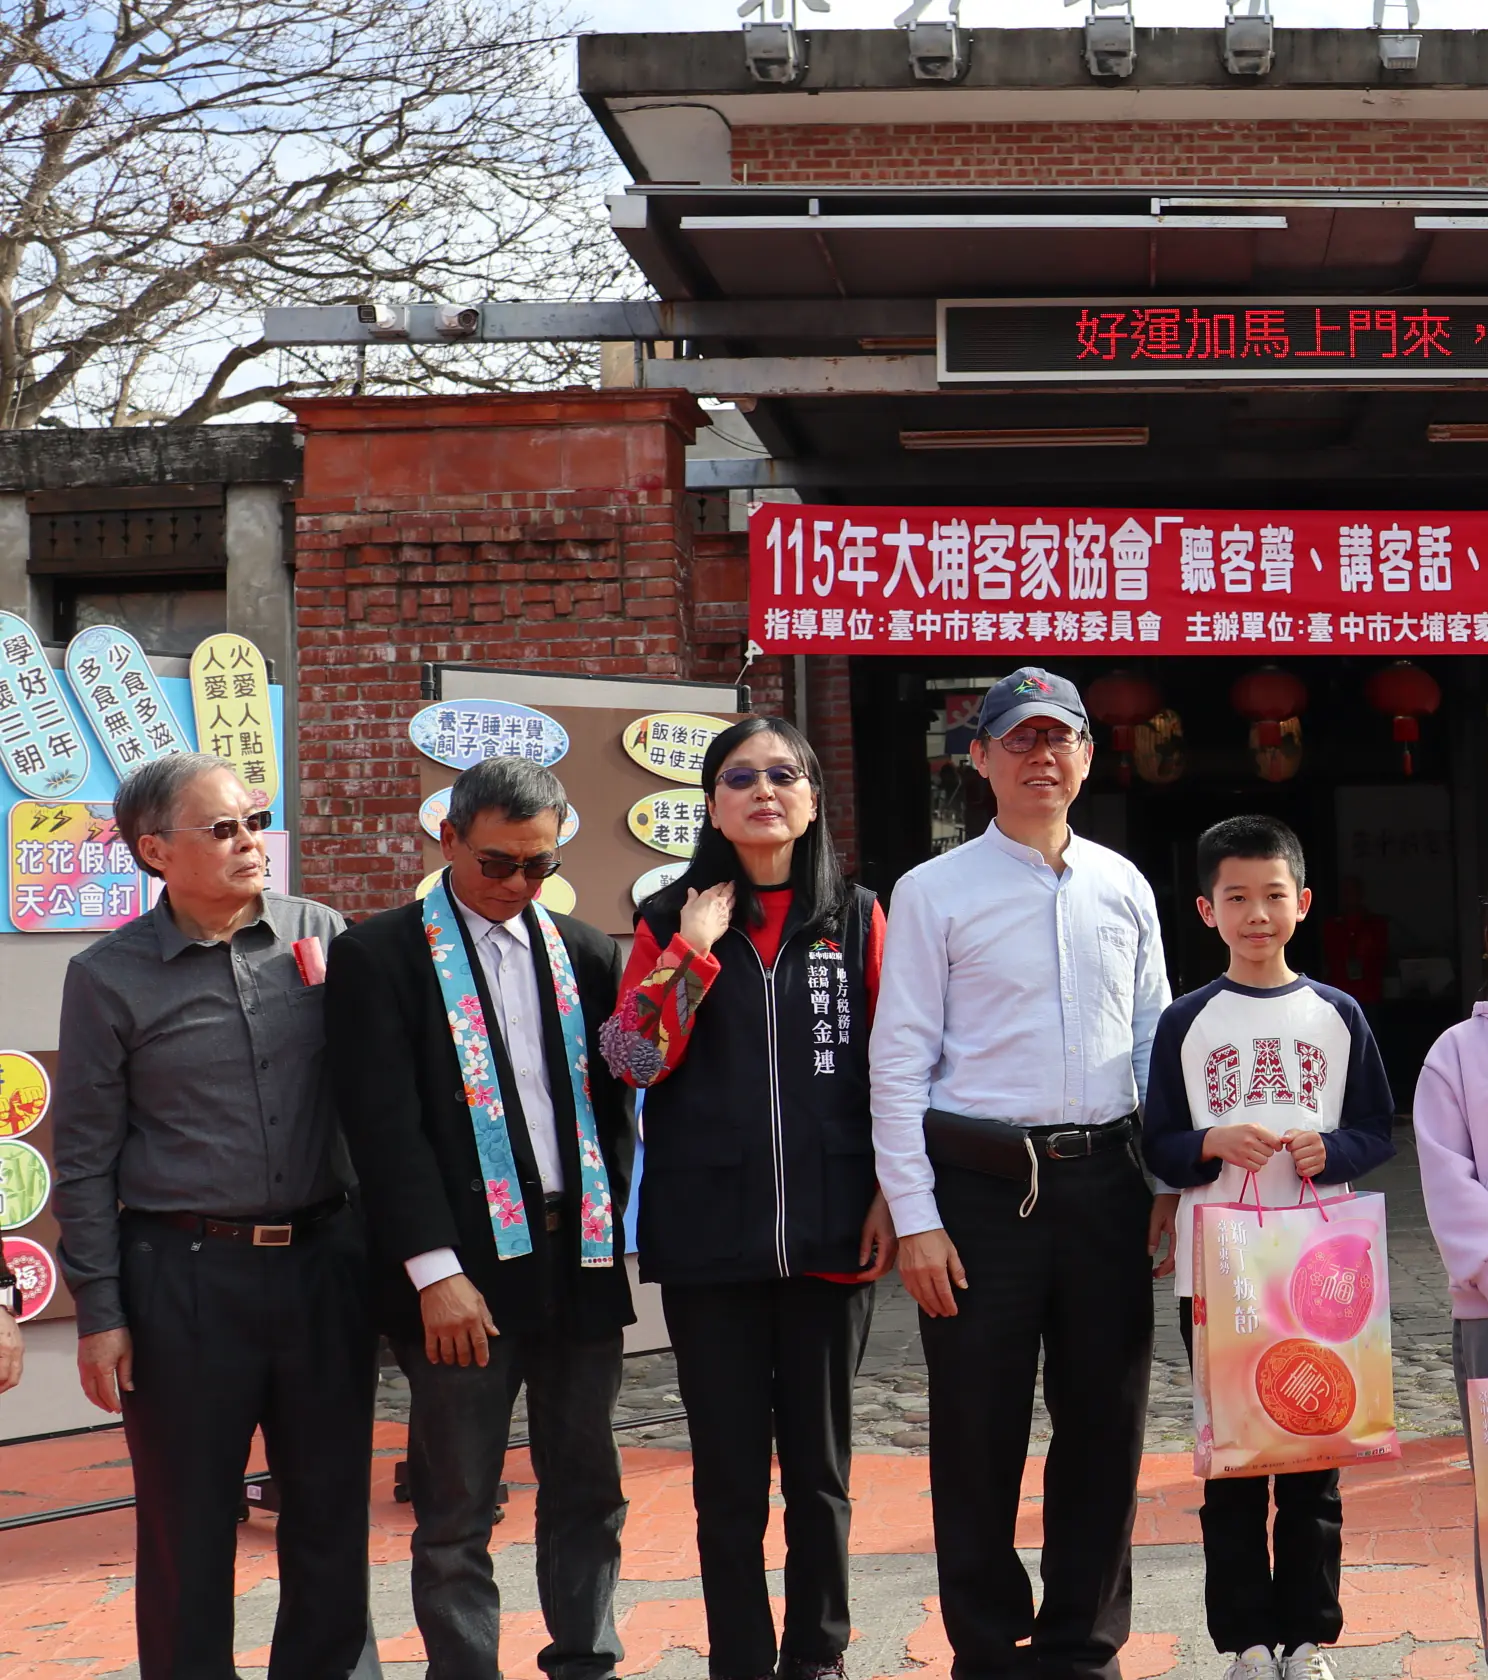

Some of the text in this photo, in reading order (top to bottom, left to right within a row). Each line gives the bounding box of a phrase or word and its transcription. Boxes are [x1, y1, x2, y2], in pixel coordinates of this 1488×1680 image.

[1076, 307, 1488, 361] 好運加馬上門來，
[764, 608, 1163, 643] 指導單位:臺中市客家事務委員會
[3, 635, 79, 760] 學好三年
[77, 657, 147, 765] 多食無味
[108, 643, 181, 756] 少食多滋
[203, 646, 237, 772] 人愛人打
[16, 840, 136, 875] 花花假假
[16, 883, 136, 917] 天公會打
[810, 989, 836, 1077] 曾金連
[1203, 1037, 1328, 1118] GAP
